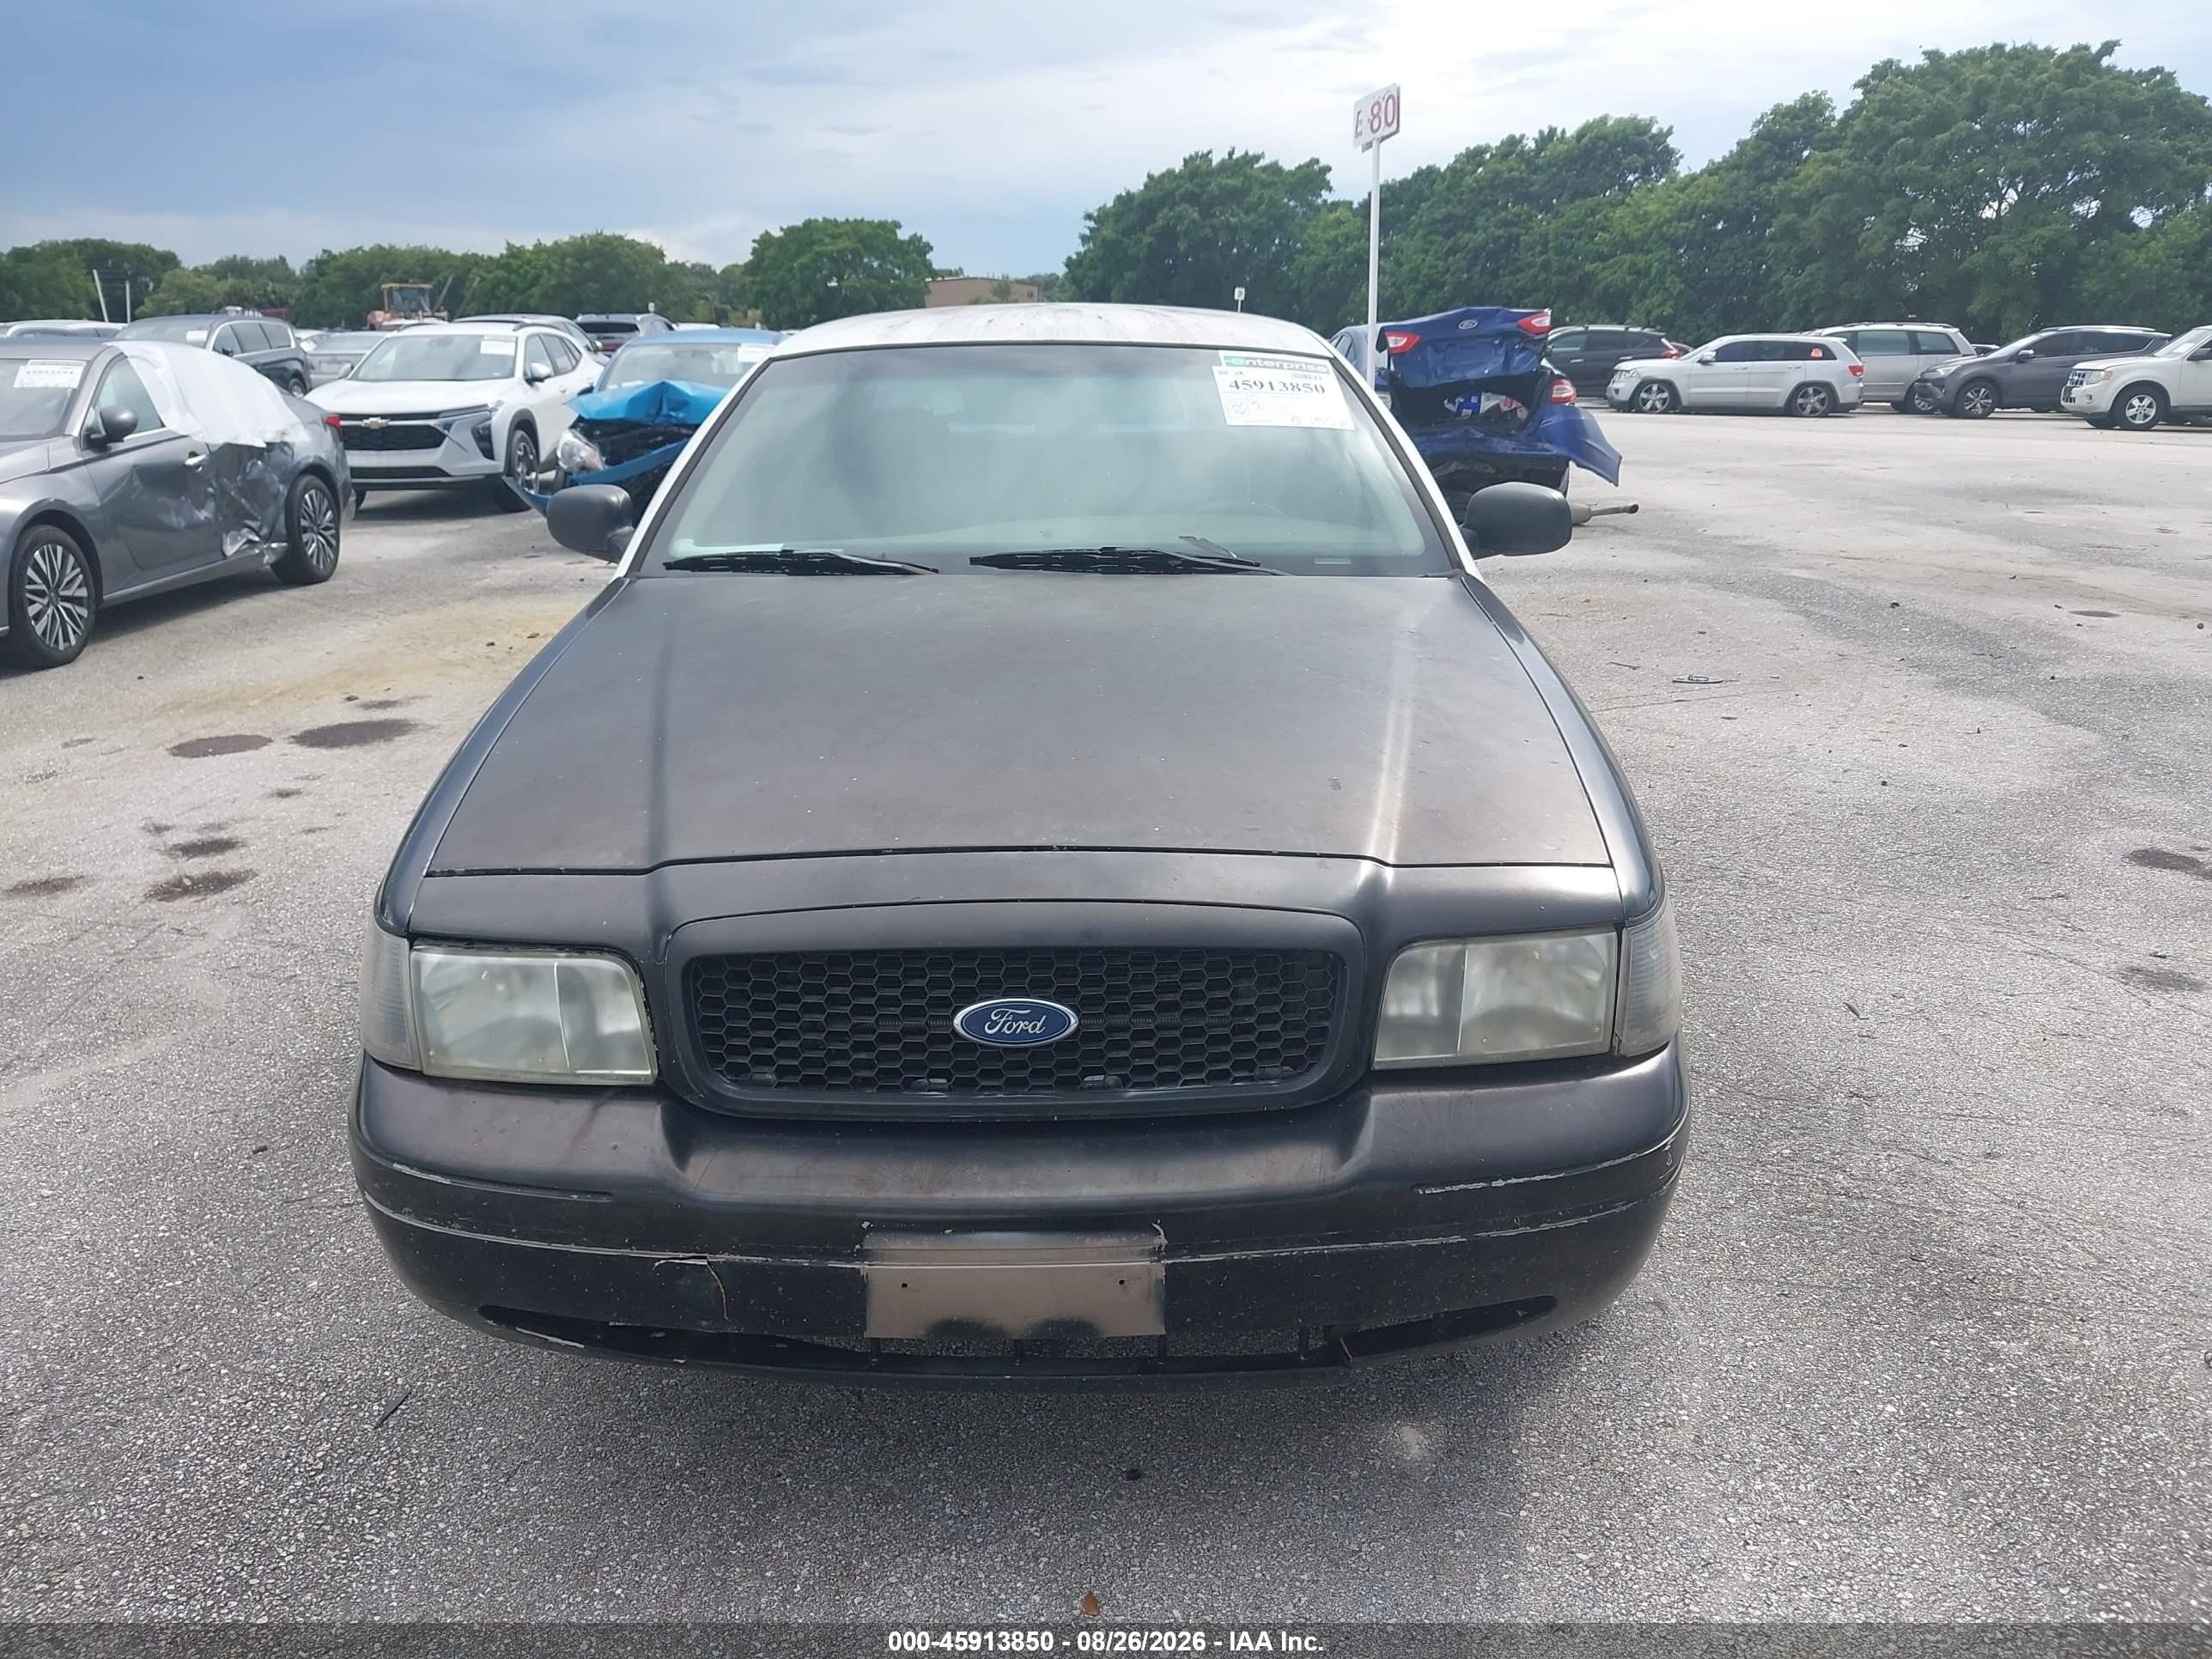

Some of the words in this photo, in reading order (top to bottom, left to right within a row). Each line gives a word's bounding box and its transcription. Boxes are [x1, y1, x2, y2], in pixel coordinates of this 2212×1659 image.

[1370, 94, 1396, 134] 80
[1229, 379, 1326, 394] 45913850
[985, 1008, 1047, 1035] Ford
